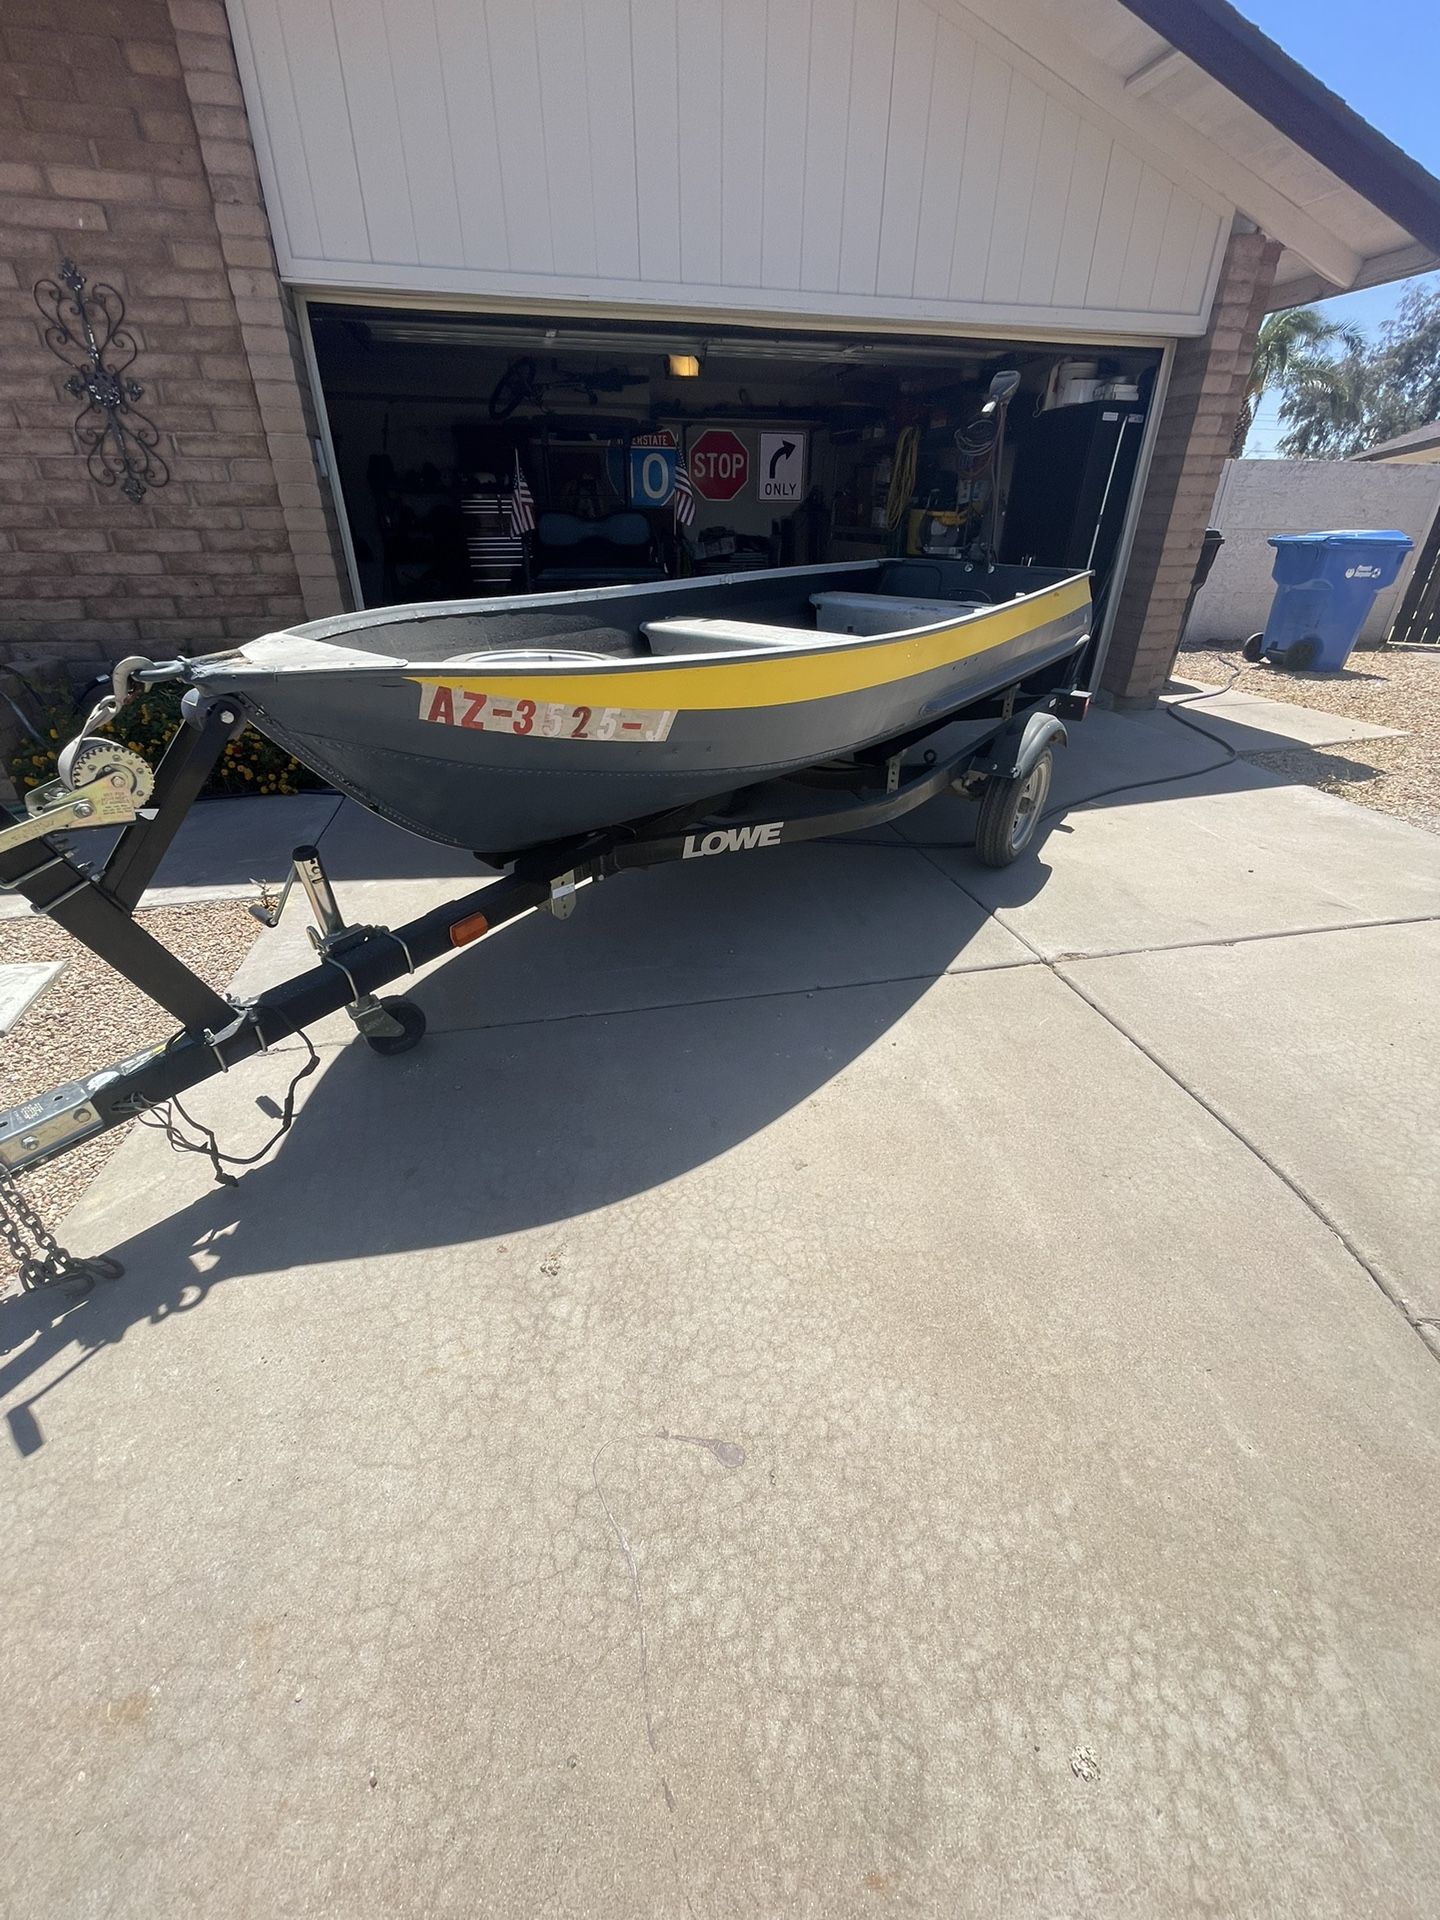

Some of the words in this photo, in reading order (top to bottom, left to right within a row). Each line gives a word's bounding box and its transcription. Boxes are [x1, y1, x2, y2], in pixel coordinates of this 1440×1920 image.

[693, 453, 744, 479] STOP
[765, 483, 797, 496] ONLY
[682, 822, 785, 859] LOWE
